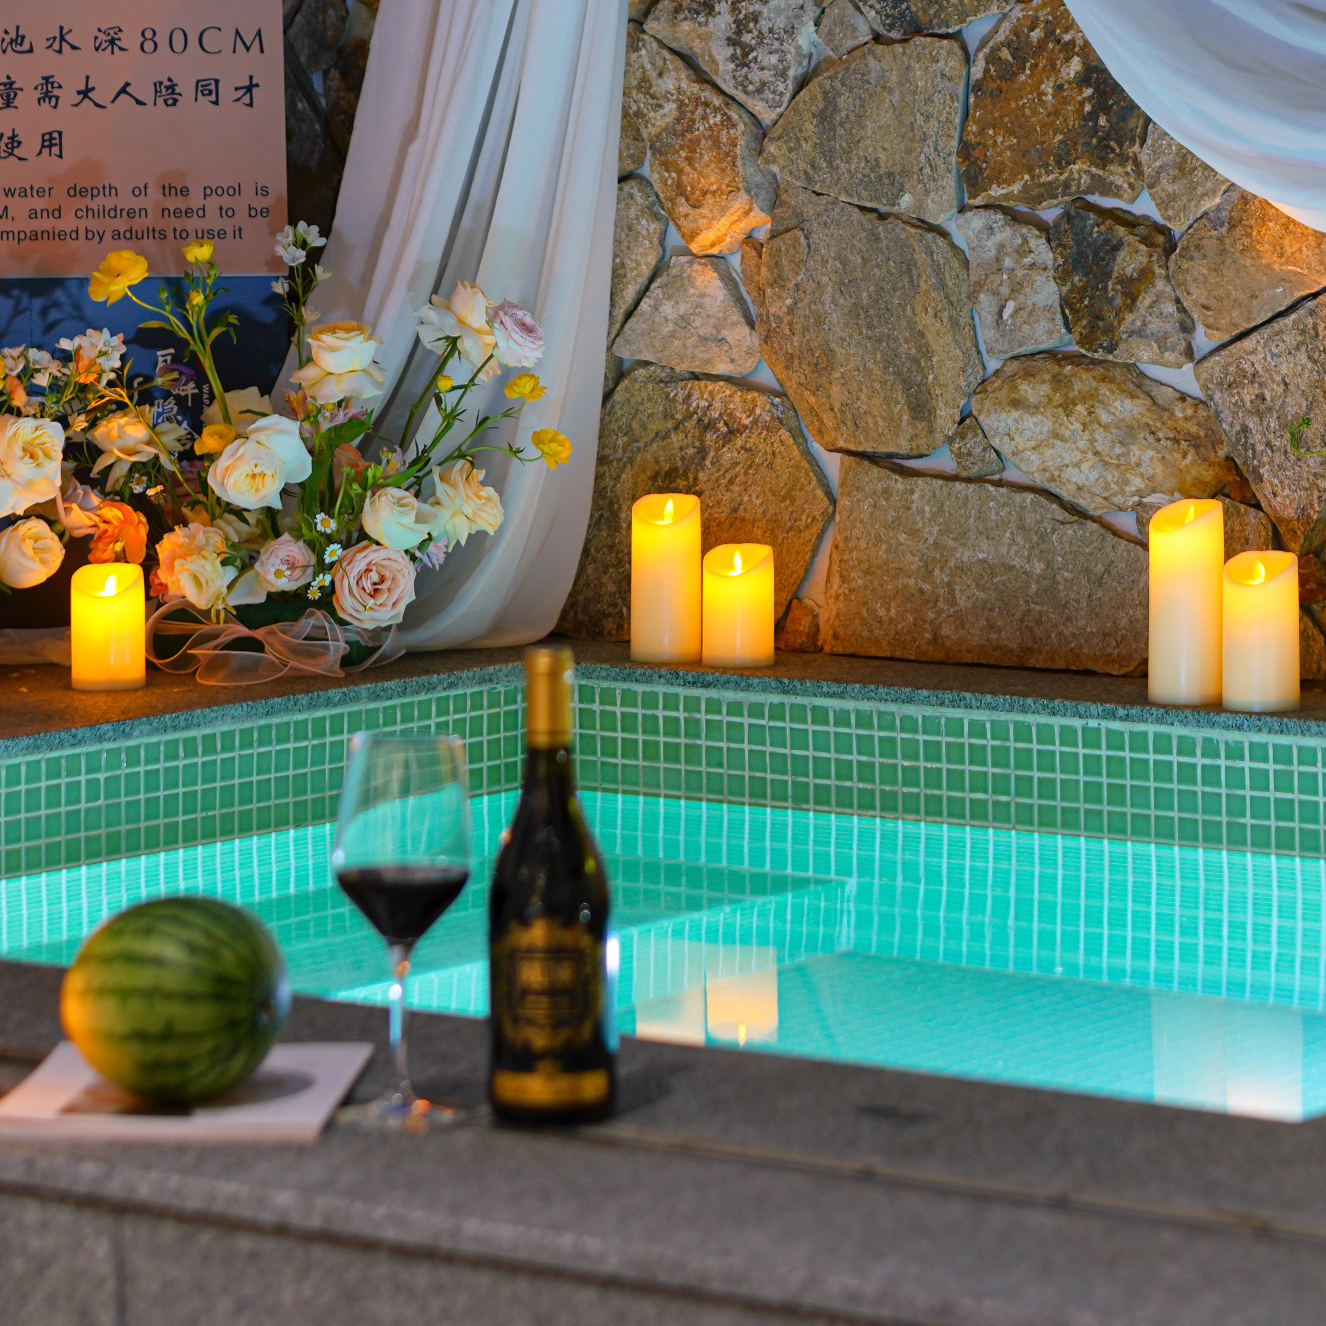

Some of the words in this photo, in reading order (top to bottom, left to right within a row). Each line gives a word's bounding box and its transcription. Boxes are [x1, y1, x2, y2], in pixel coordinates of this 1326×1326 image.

[3, 184, 54, 198] water
[67, 183, 118, 202] depth
[132, 182, 149, 197] of
[162, 183, 190, 197] the
[203, 183, 242, 201] pool
[255, 182, 269, 196] is
[28, 205, 62, 219] and
[75, 205, 148, 219] children
[161, 204, 206, 218] need
[219, 205, 235, 218] to
[249, 204, 270, 218] be
[85, 226, 106, 245] by
[111, 226, 167, 240] adults
[173, 226, 189, 240] to
[195, 229, 227, 240] use
[232, 225, 243, 239] it
